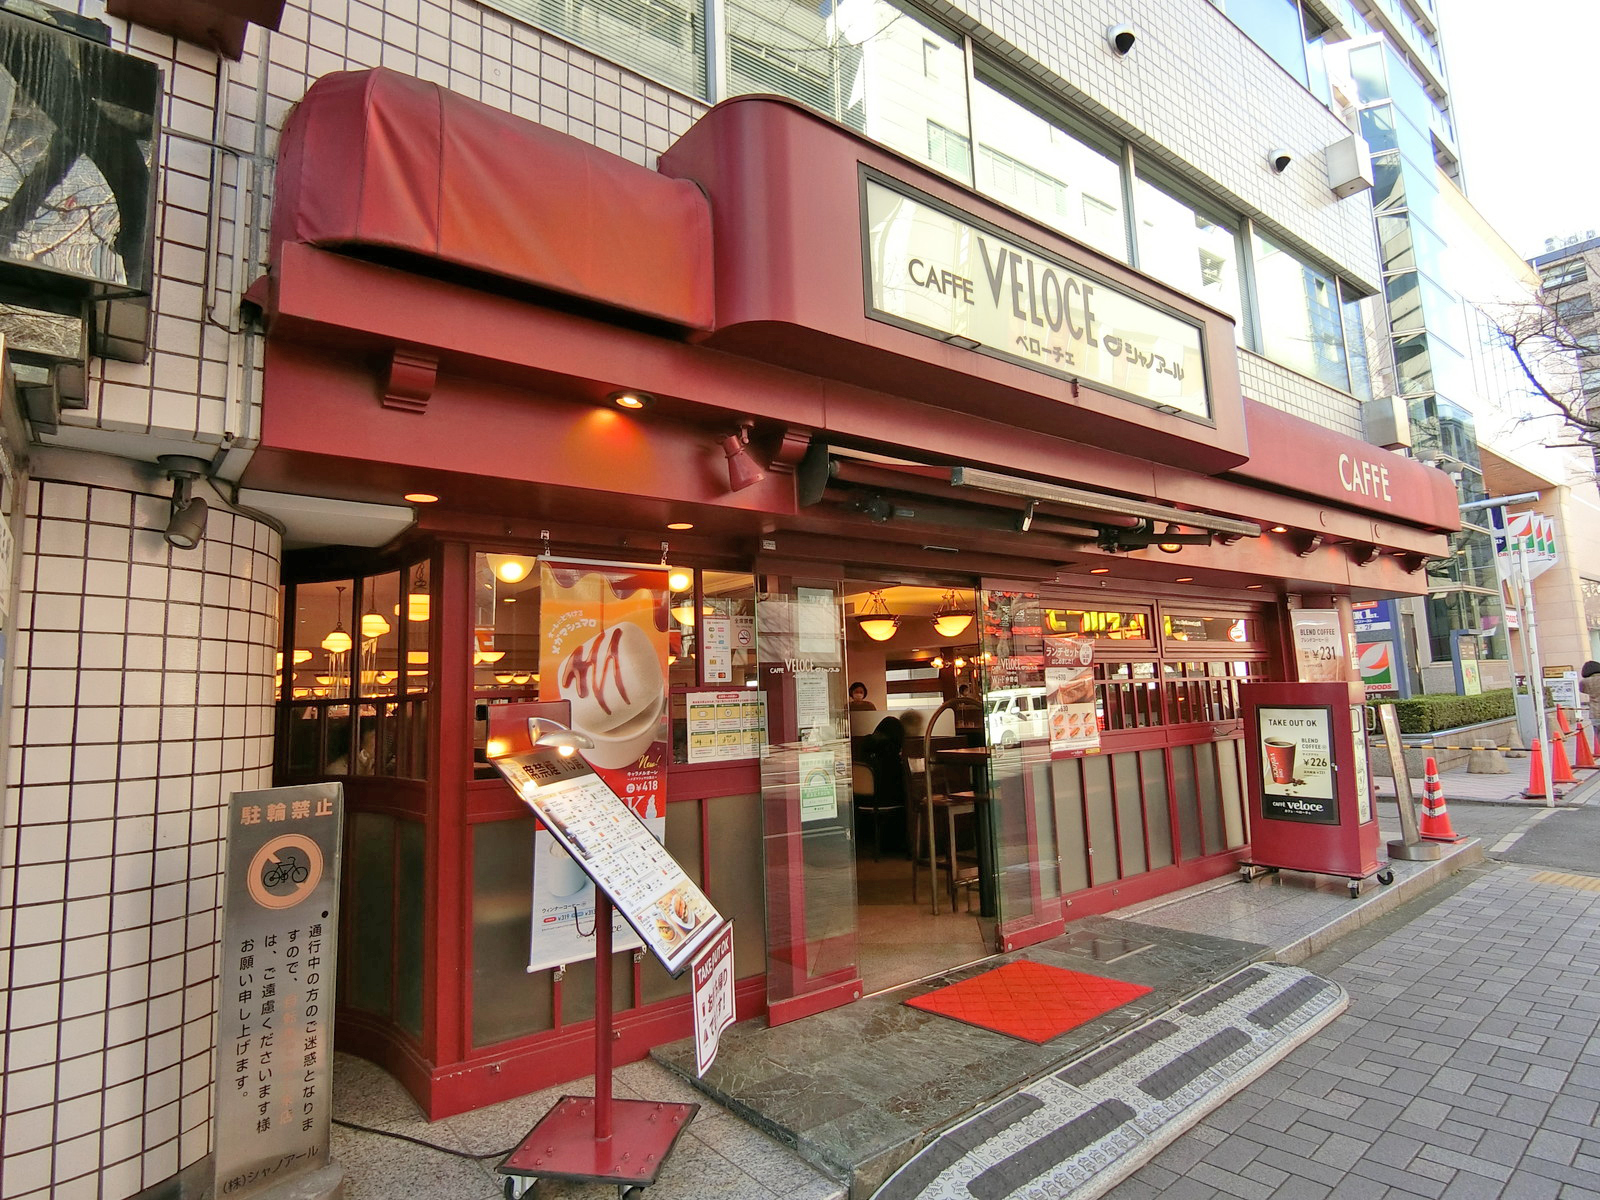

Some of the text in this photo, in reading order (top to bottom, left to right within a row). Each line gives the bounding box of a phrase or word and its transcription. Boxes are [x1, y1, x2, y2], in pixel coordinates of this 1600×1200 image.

[977, 236, 1099, 349] VELOCE
[1015, 335, 1076, 367] ベローチェ
[1125, 342, 1185, 382] シャノアール
[1338, 453, 1392, 502] CAFFÈ
[551, 618, 597, 655] メガマシュマロ
[1300, 628, 1335, 636] BLEND COFFEE
[785, 658, 814, 672] VELOCE
[1001, 658, 1020, 670] VELOCE
[1045, 646, 1080, 657] ランチセット
[1312, 646, 1336, 660] ¥231
[1367, 683, 1392, 691] FOODS
[1268, 719, 1317, 727] TAKE OUT OK
[1303, 757, 1327, 767] ¥226
[635, 780, 658, 791] ¥418
[240, 798, 334, 826] 駐輪禁止
[1287, 800, 1324, 812] veloce
[697, 958, 713, 985] TAKE
[721, 935, 730, 954] OK
[234, 938, 255, 1100] お願い申し上げます。
[302, 923, 323, 1132] 通行中の方のご迷惑となりま
[256, 933, 278, 1135] は、ご遠慮くださいます様
[222, 1144, 320, 1195] (株)シャノアール
